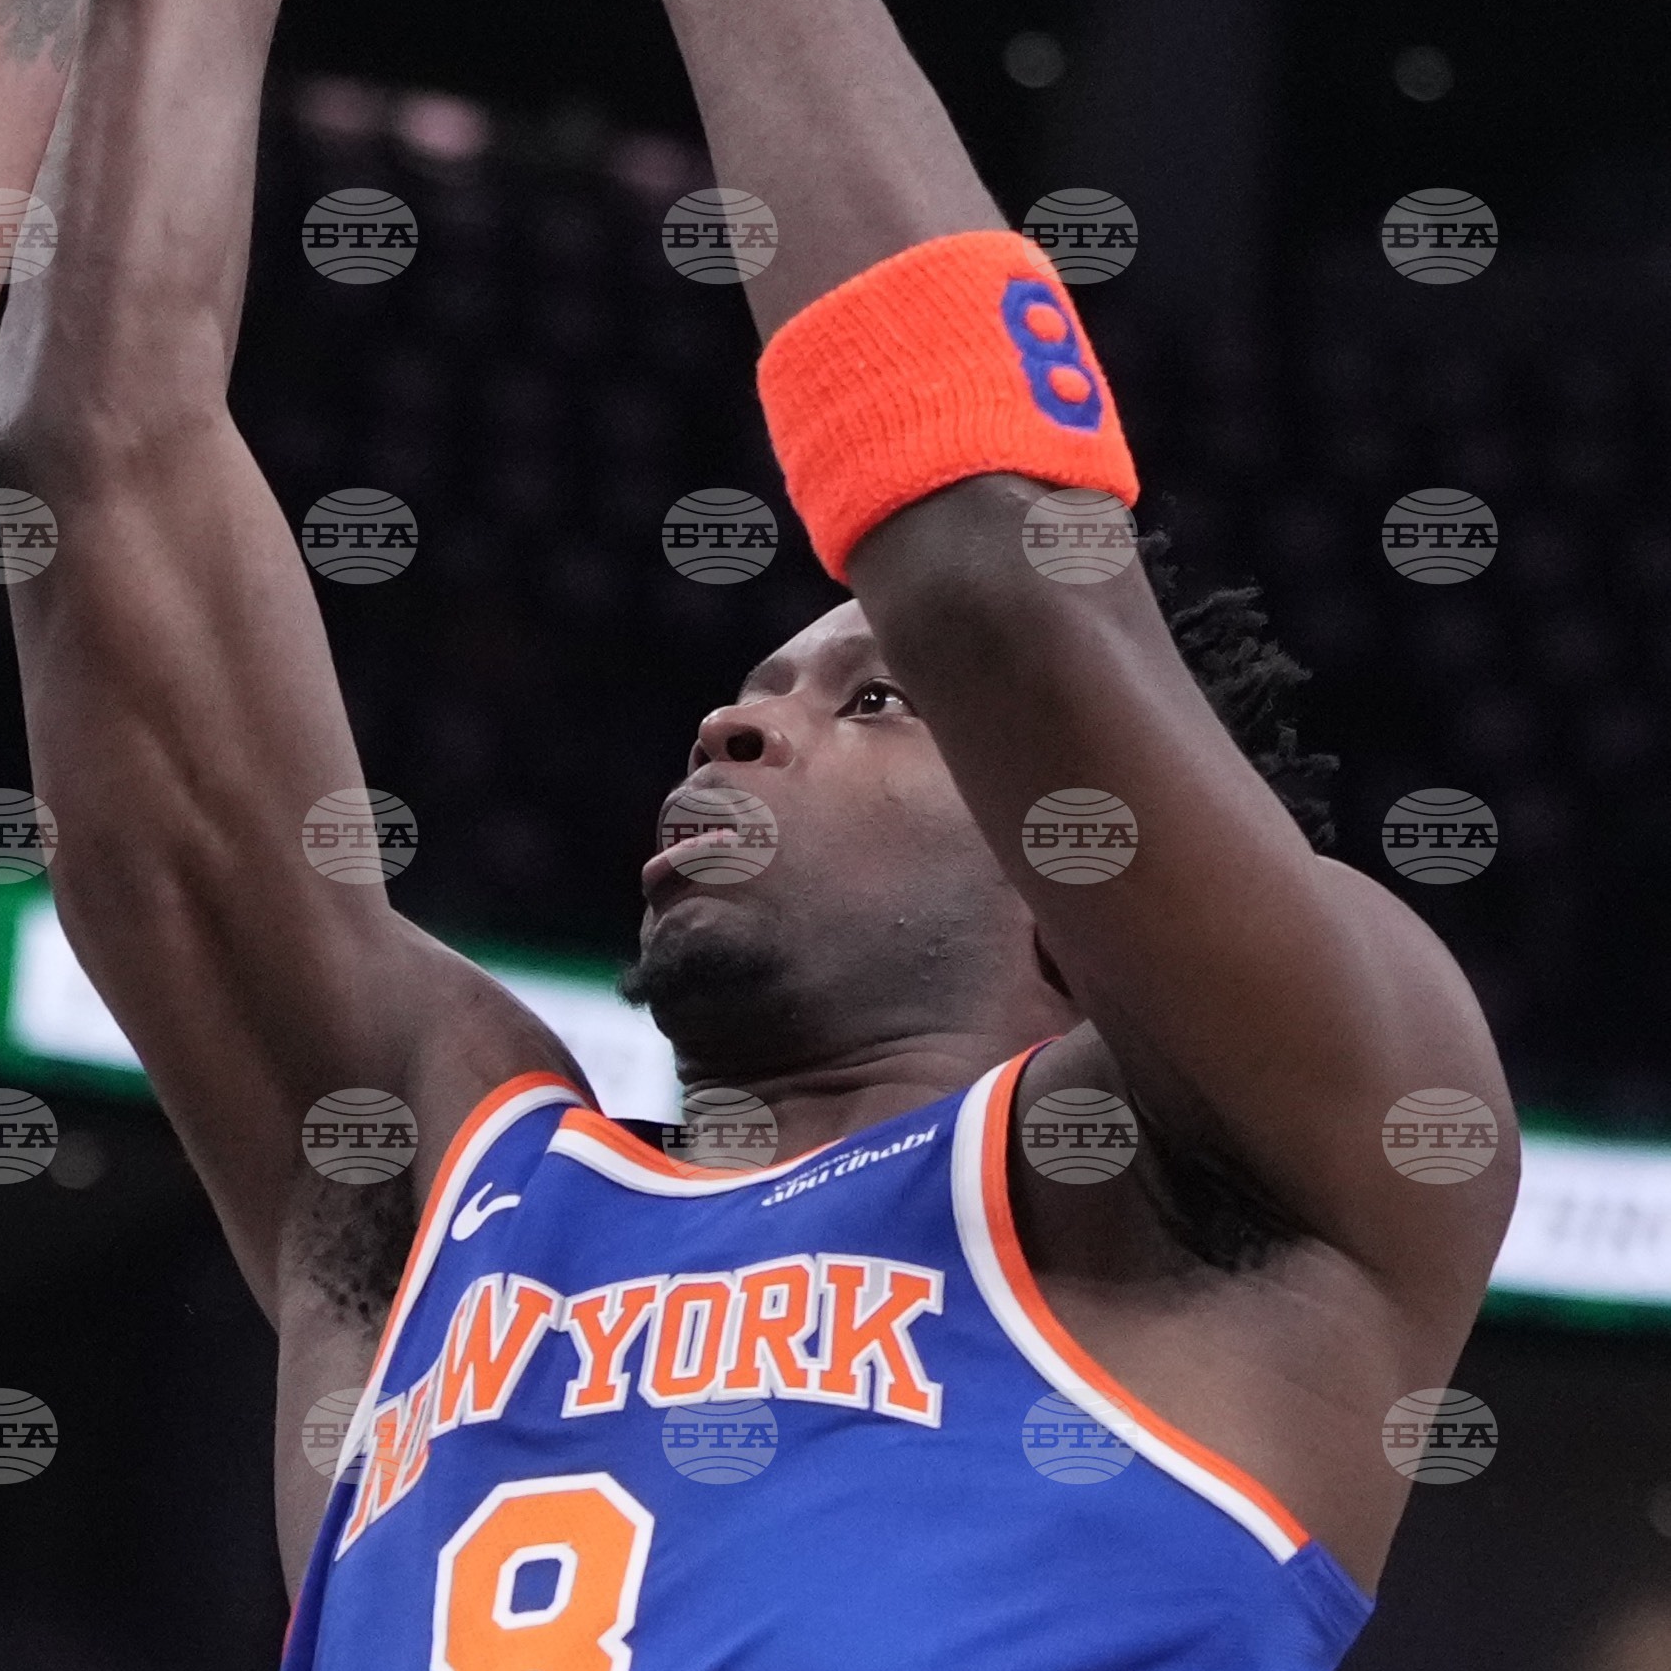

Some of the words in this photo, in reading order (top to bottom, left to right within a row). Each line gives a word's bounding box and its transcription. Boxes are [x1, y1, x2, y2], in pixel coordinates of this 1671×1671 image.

[1000, 276, 1103, 433] 8
[761, 1169, 830, 1207] abu
[833, 1123, 939, 1178] dhabi
[561, 1253, 945, 1428] YORK
